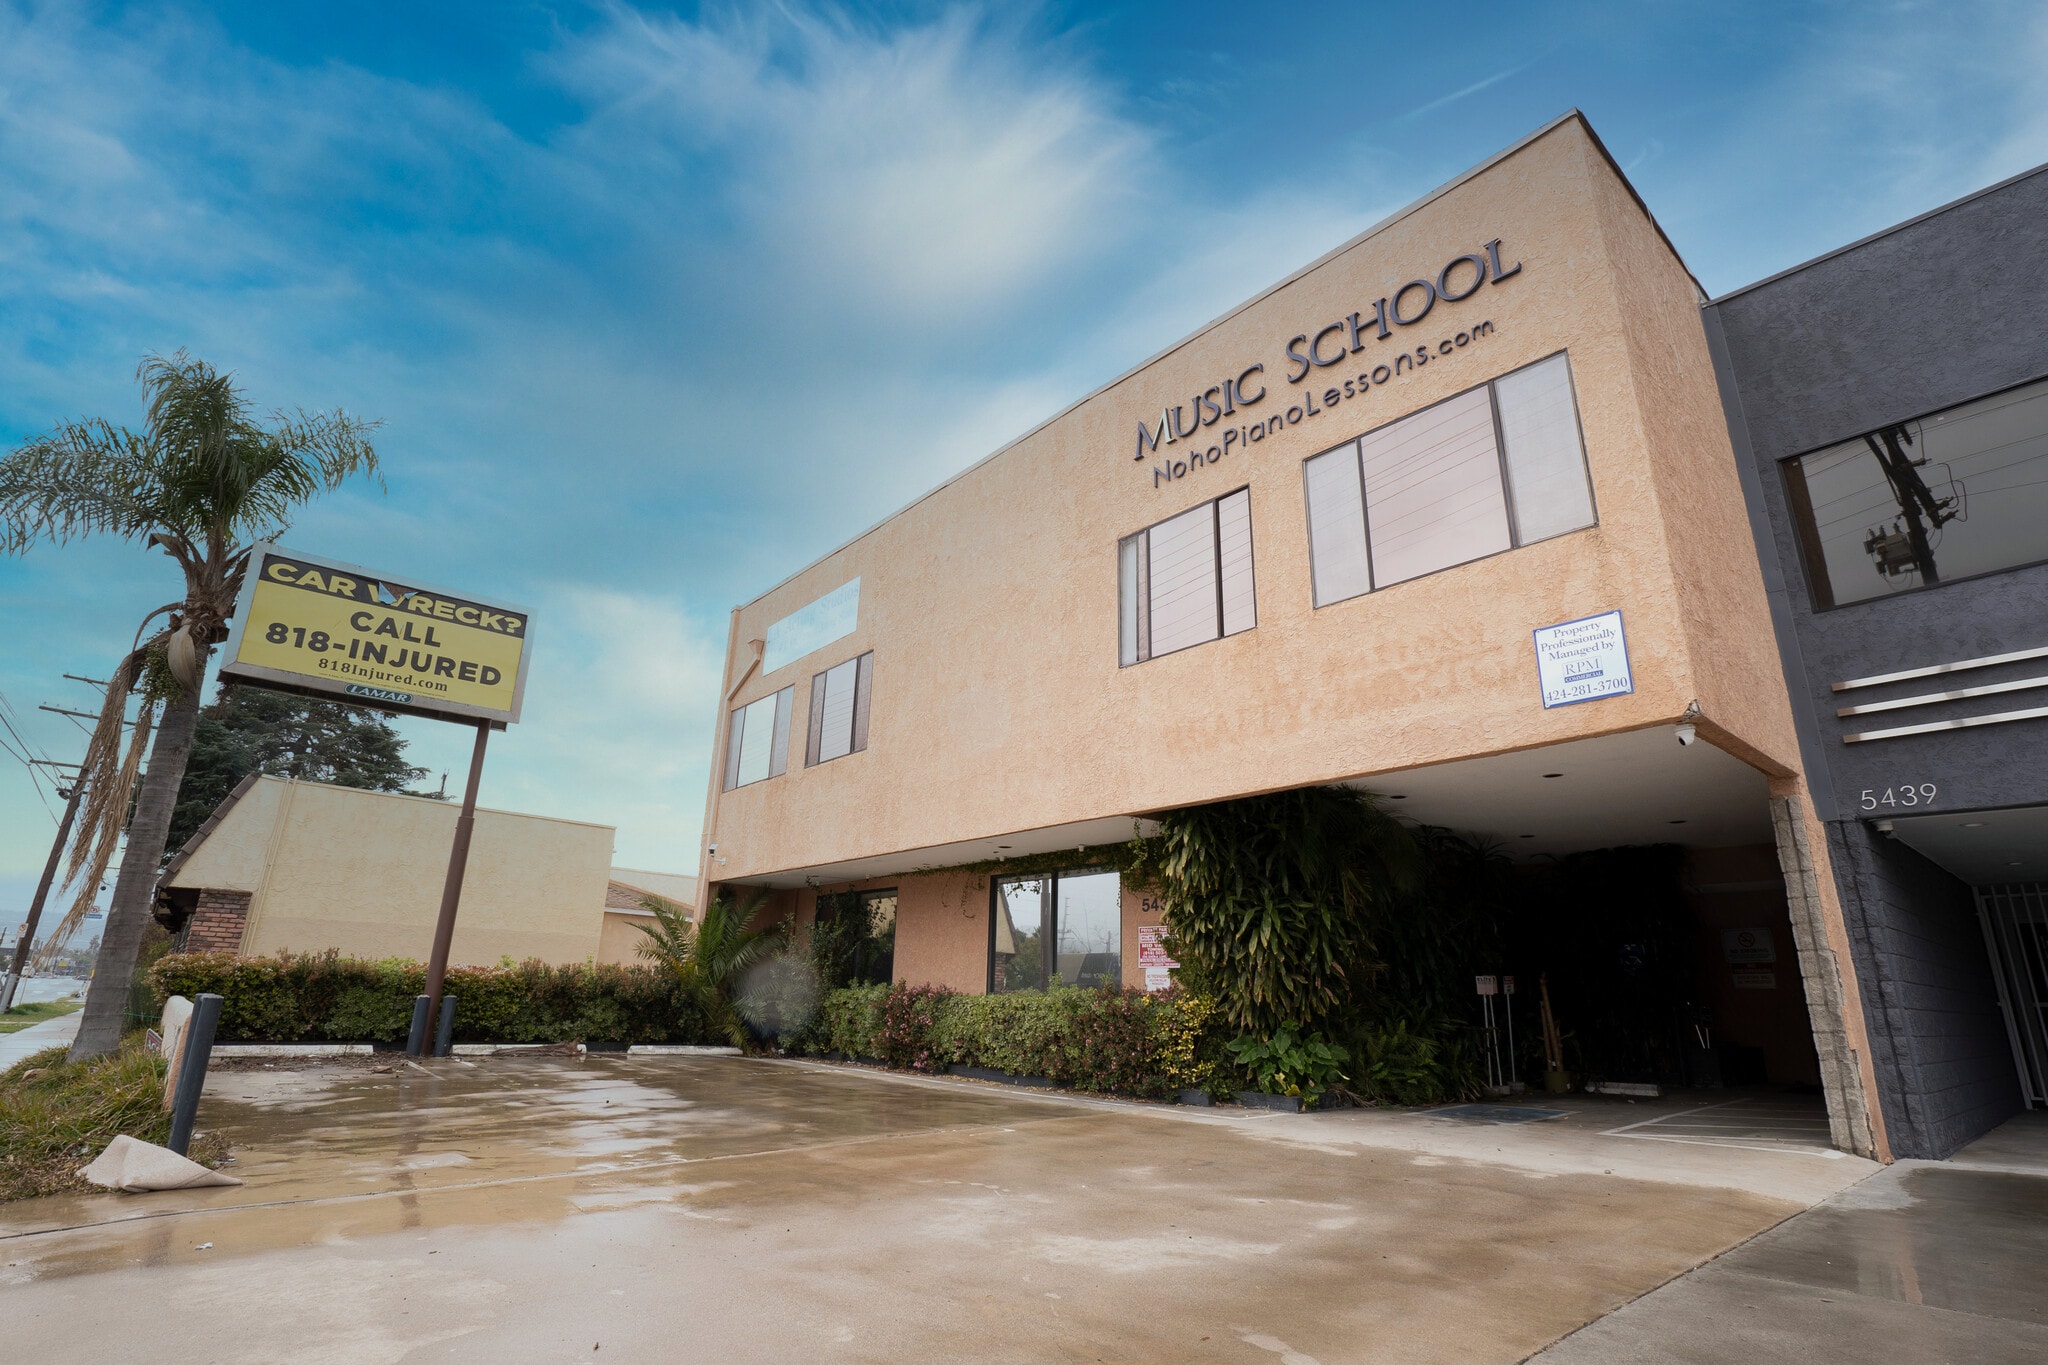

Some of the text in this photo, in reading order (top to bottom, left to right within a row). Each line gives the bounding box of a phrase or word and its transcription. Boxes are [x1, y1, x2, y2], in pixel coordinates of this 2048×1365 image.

[1133, 238, 1522, 461] MUSIC SCHOOL
[1153, 319, 1494, 488] NohoPianoLessons.com
[267, 562, 356, 598] CAR
[350, 611, 441, 648] CALL
[1541, 629, 1616, 652] Professionally
[1553, 622, 1601, 638] Property
[265, 622, 502, 686] 818-INJURED
[1549, 641, 1616, 661] Managed by
[318, 658, 448, 692] 818Injured.com
[1565, 658, 1599, 675] RPM
[349, 684, 411, 703] LAMAR
[1546, 677, 1628, 701] 424-281-3700
[1861, 783, 1937, 810] 5439
